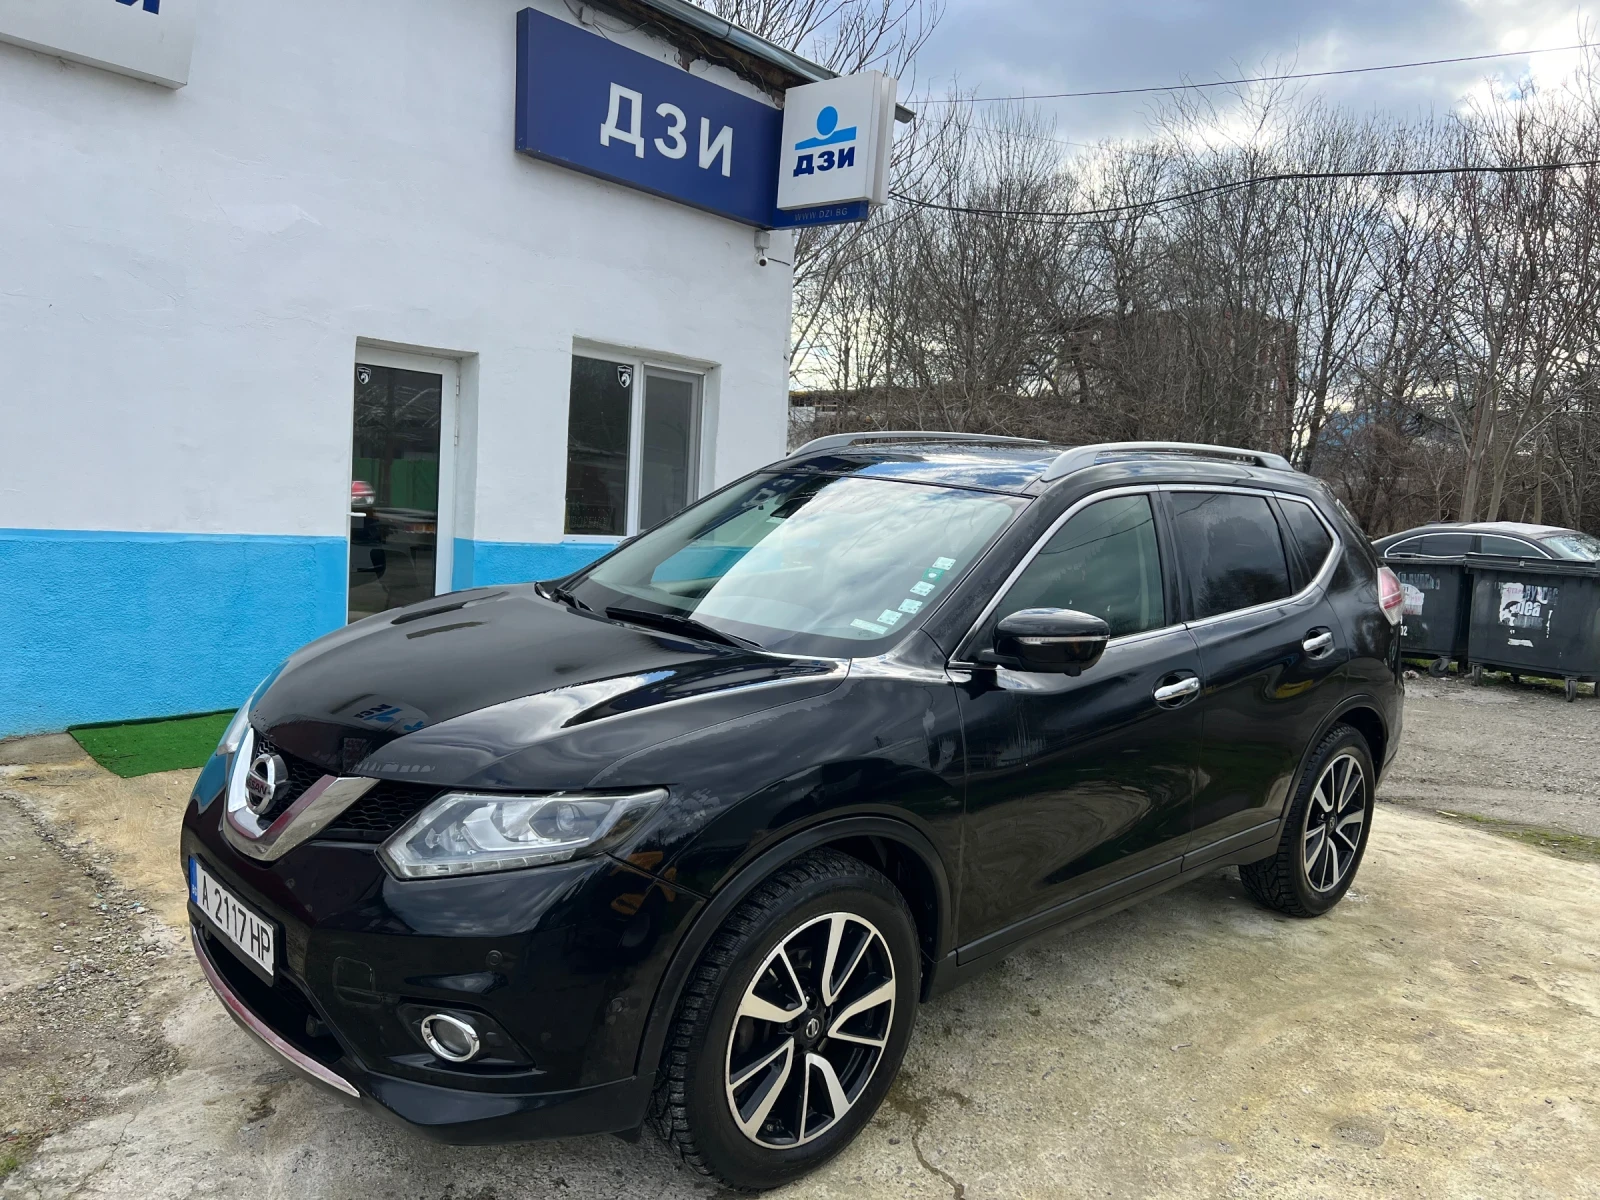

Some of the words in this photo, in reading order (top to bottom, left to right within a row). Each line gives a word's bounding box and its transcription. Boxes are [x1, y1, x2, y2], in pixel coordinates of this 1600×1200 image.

[600, 82, 733, 178] ДЗИ
[793, 146, 856, 177] ДЗИ
[202, 875, 209, 911] A
[214, 888, 246, 943] 2117
[249, 917, 271, 962] HP
